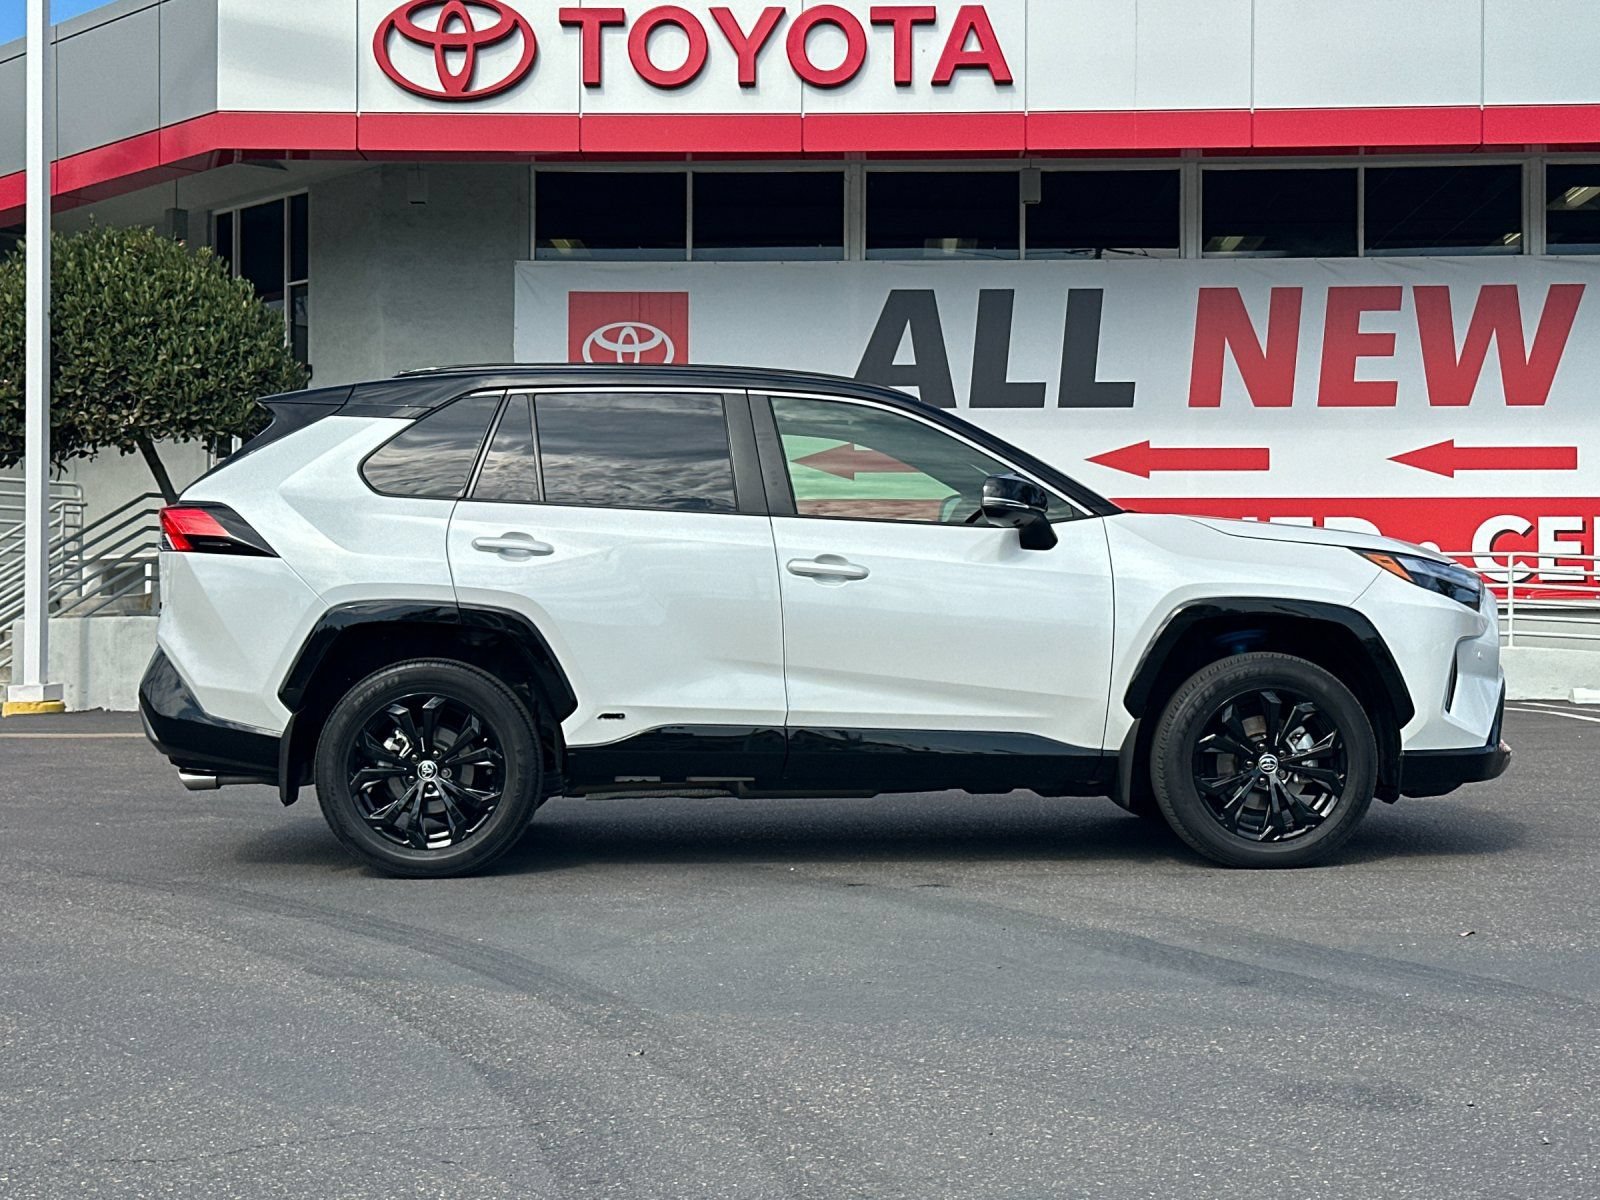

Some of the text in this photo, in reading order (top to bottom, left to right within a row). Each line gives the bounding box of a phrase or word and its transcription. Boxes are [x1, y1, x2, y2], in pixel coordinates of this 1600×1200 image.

[559, 5, 1013, 87] TOYOTA
[853, 285, 1586, 408] ALL NEW
[1471, 514, 1600, 584] CE
